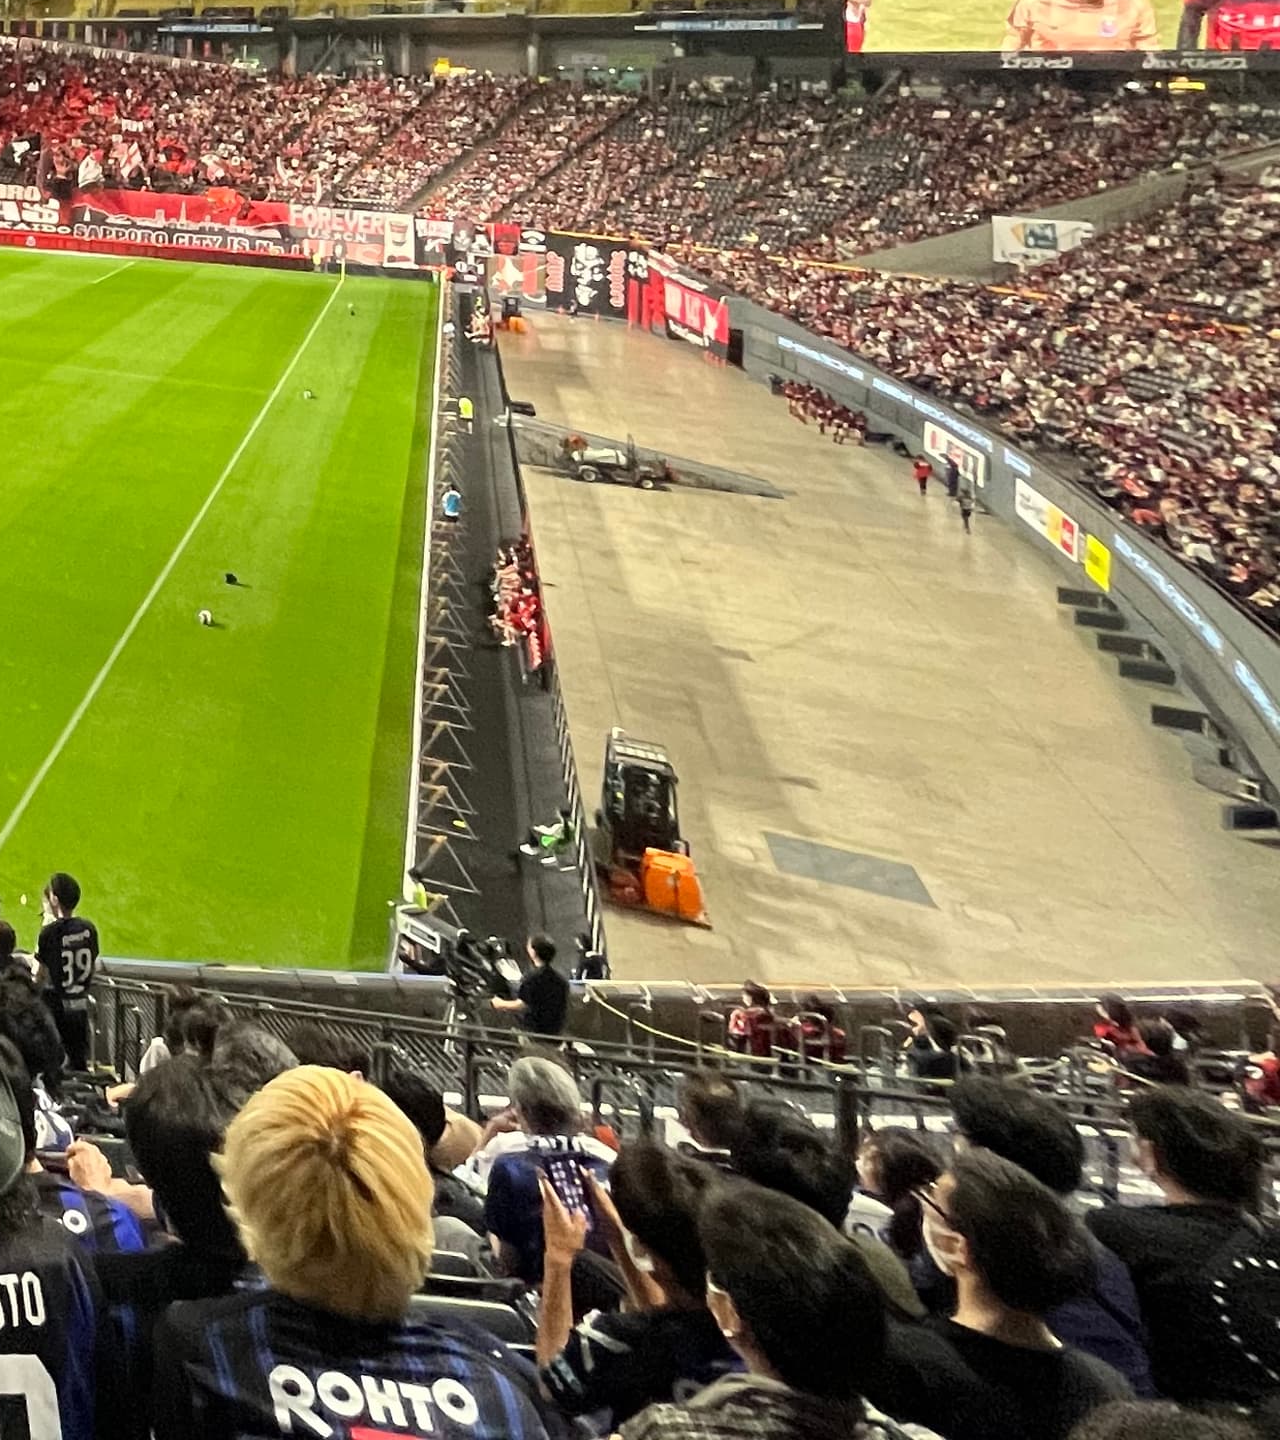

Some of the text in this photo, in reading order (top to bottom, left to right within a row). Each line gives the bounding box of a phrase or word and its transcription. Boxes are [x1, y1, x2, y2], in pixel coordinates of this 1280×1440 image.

[74, 223, 168, 247] SAPPORO
[291, 206, 385, 234] FOREVER
[61, 947, 92, 989] 39
[268, 1364, 479, 1438] ROHTO
